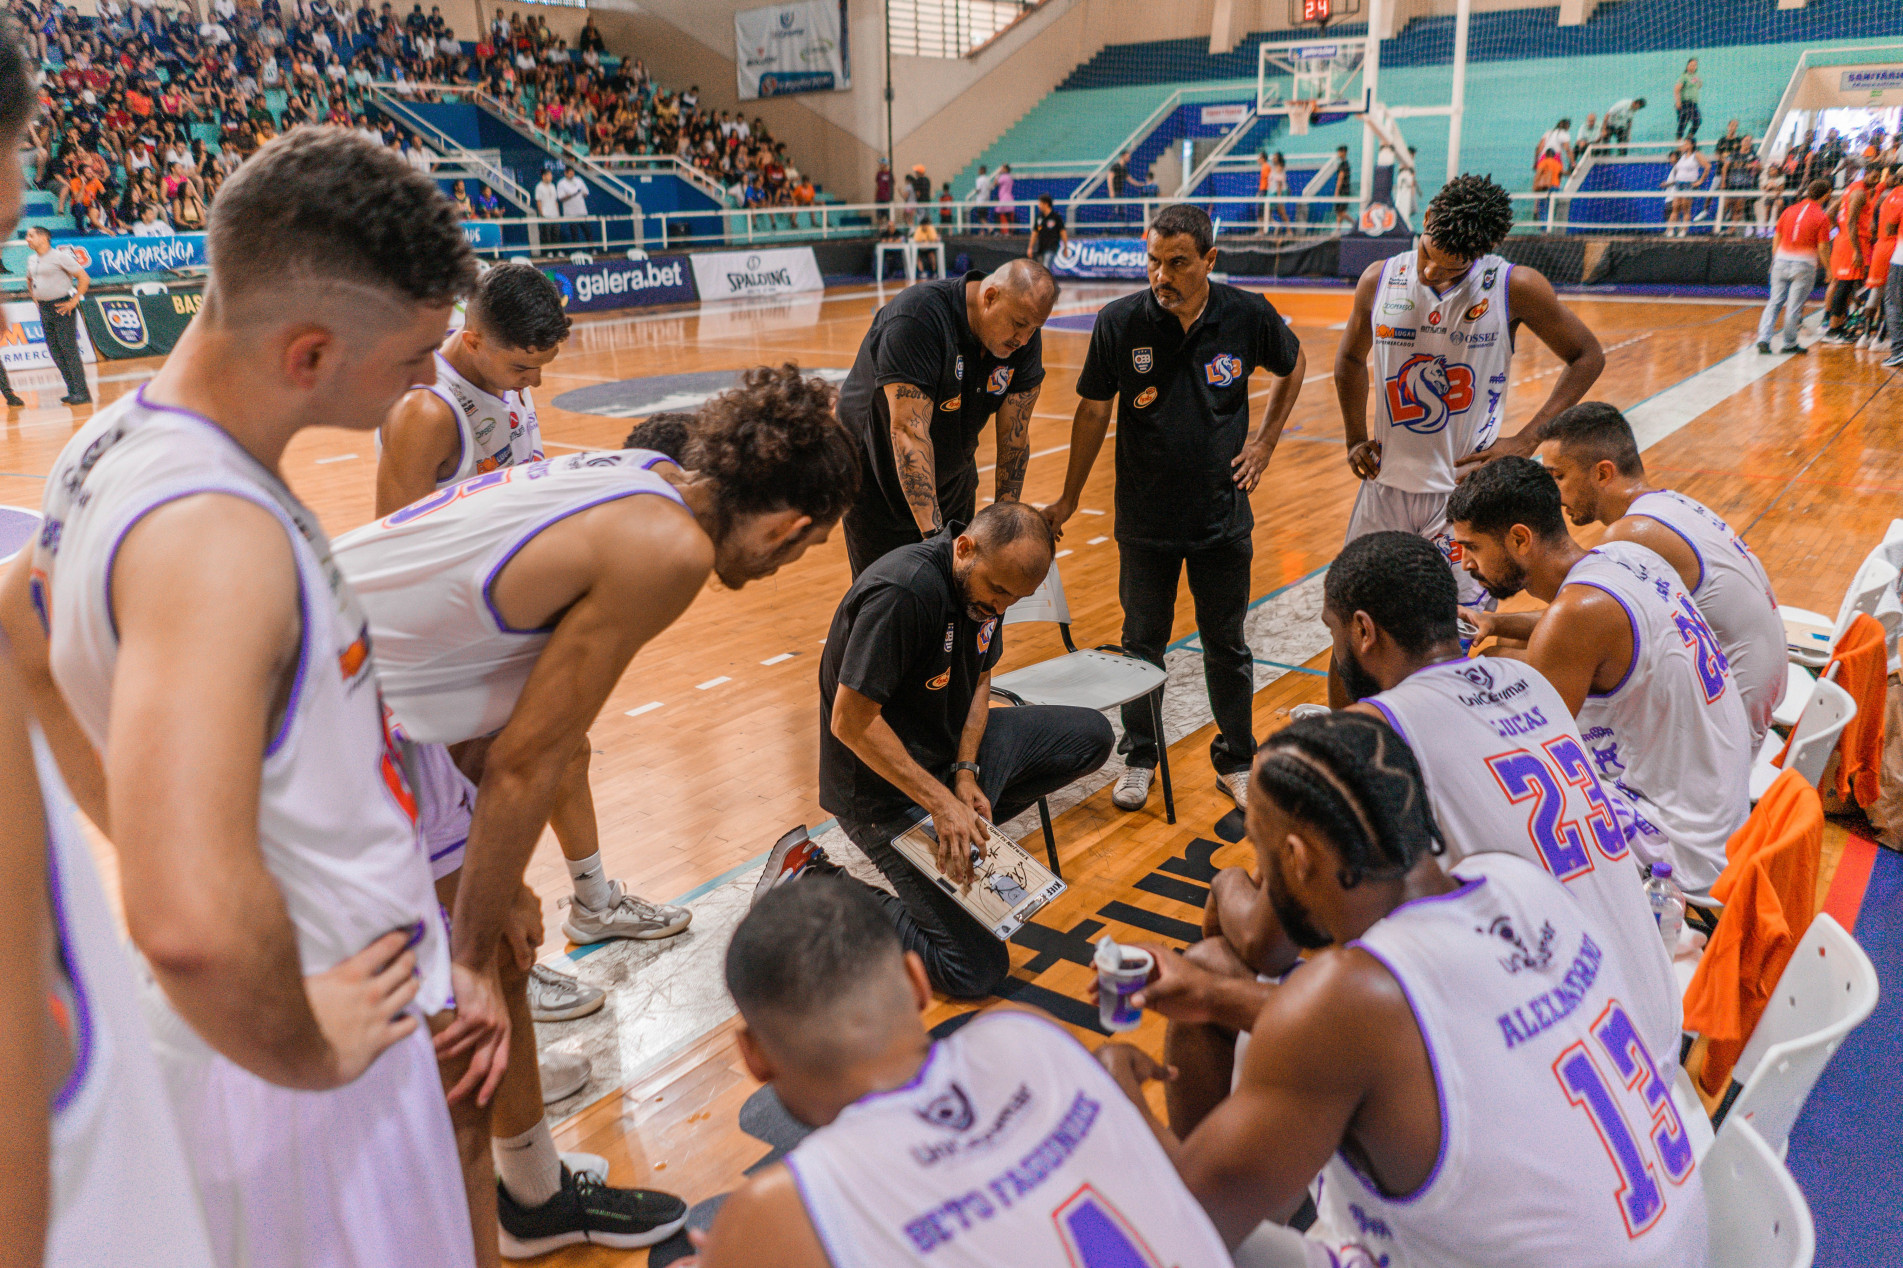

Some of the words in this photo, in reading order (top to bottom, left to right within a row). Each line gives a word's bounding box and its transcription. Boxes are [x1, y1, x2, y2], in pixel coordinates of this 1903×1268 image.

[1305, 0, 1328, 19] 24
[99, 237, 194, 275] TRANSPARÊNCIA
[1080, 245, 1148, 267] UniCesu
[576, 261, 683, 302] galera.bet
[727, 267, 792, 293] SPALDING
[172, 294, 204, 315] BAS
[25, 326, 45, 339] LU
[1395, 330, 1415, 338] LUGAR
[1465, 332, 1498, 344] OSSEL
[1484, 733, 1630, 883] 23
[1552, 998, 1696, 1241] 13
